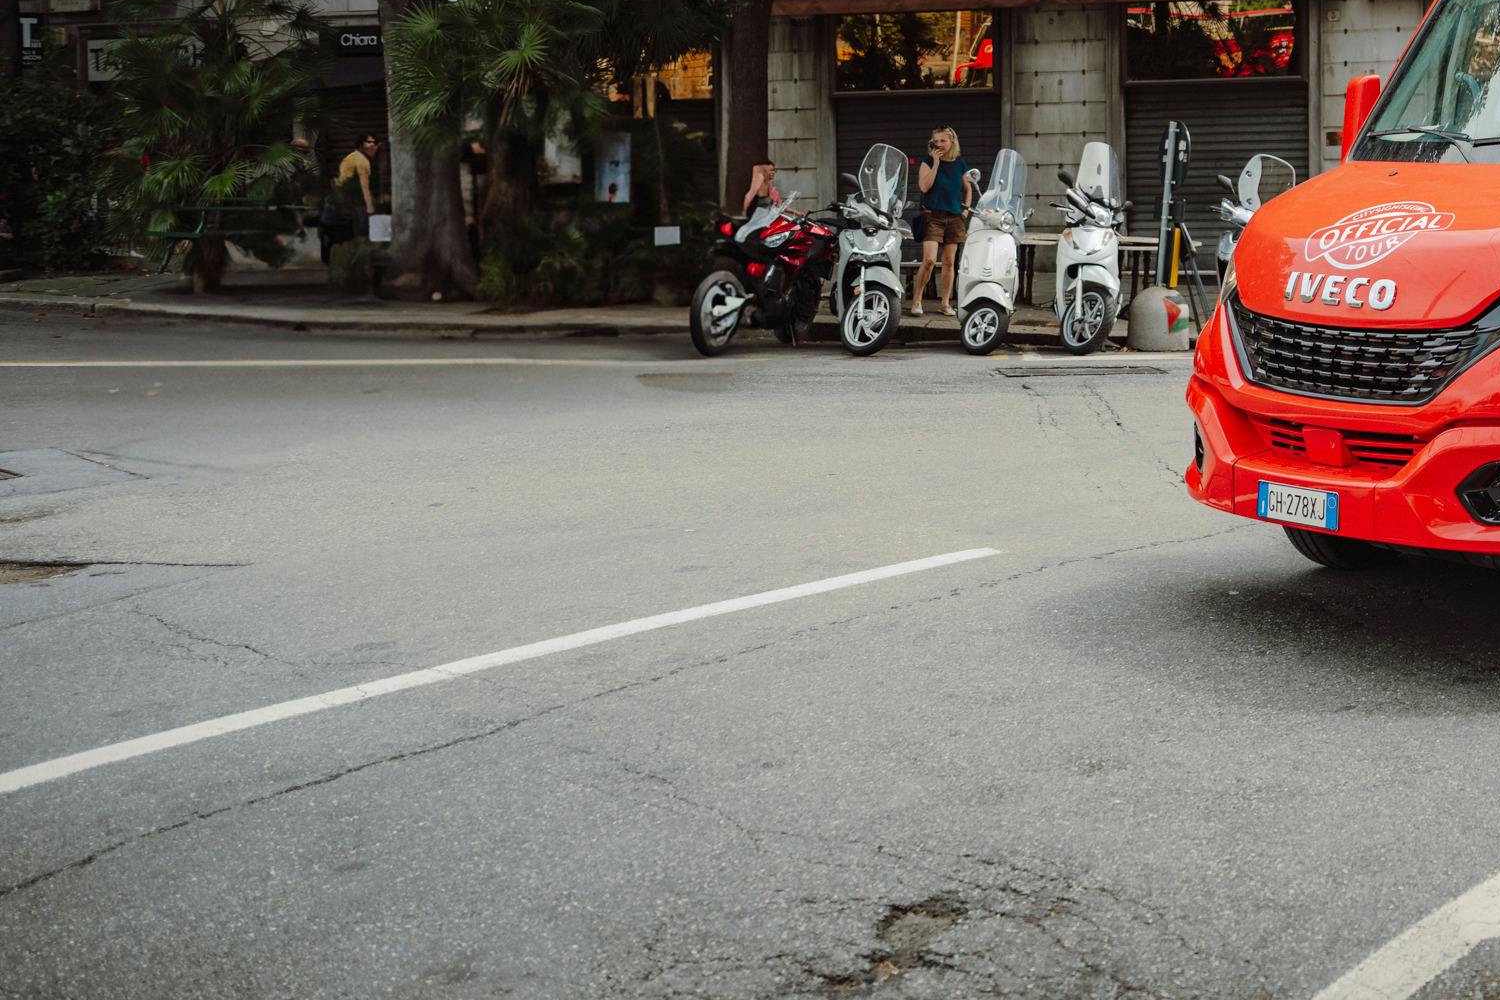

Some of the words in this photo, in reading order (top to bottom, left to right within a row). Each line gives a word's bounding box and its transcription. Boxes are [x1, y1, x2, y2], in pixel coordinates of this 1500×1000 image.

[341, 33, 377, 47] Chiara
[1319, 215, 1442, 249] OFFICIAL
[1345, 235, 1400, 261] TOUR
[1284, 271, 1397, 311] IVECO
